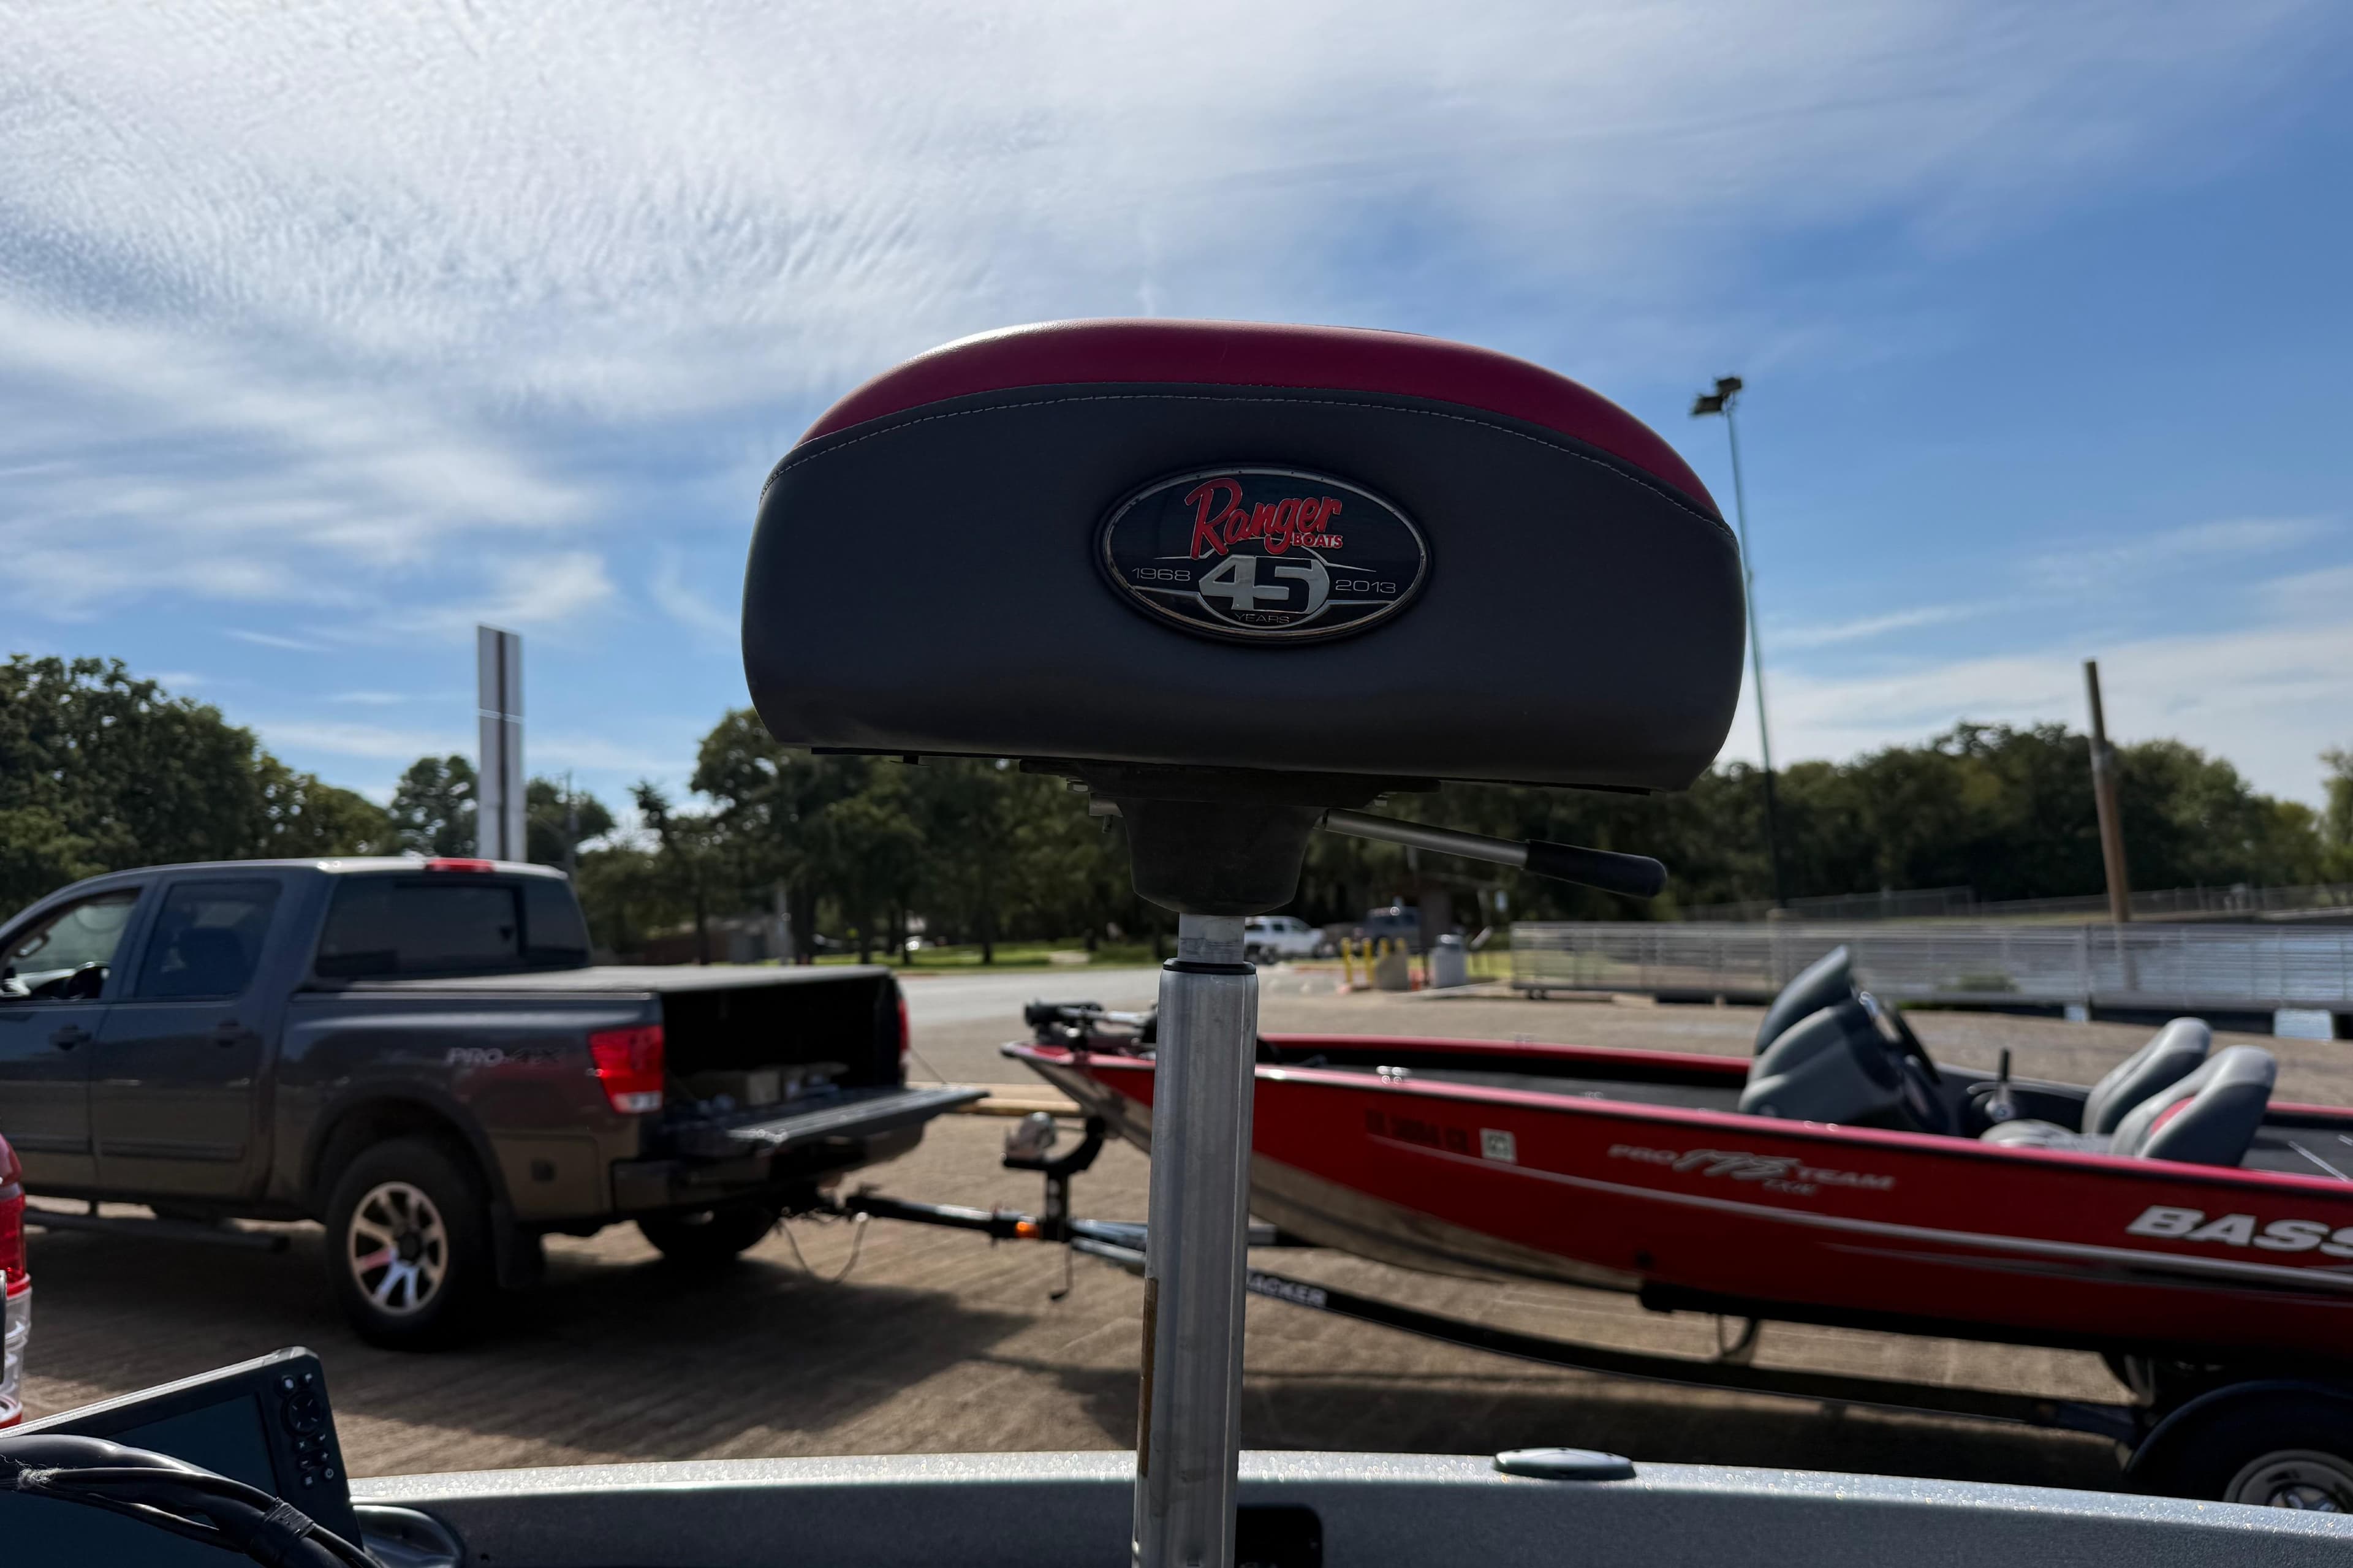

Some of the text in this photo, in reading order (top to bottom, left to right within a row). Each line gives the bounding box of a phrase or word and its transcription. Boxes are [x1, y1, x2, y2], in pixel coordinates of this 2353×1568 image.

[1185, 477, 1342, 560] Ranger
[1292, 534, 1343, 549] BOATS
[1131, 554, 1396, 614] 1968 45 2013
[1235, 613, 1290, 624] YEARS
[1607, 1143, 1678, 1162] PRO
[1798, 1165, 1896, 1191] TEAM
